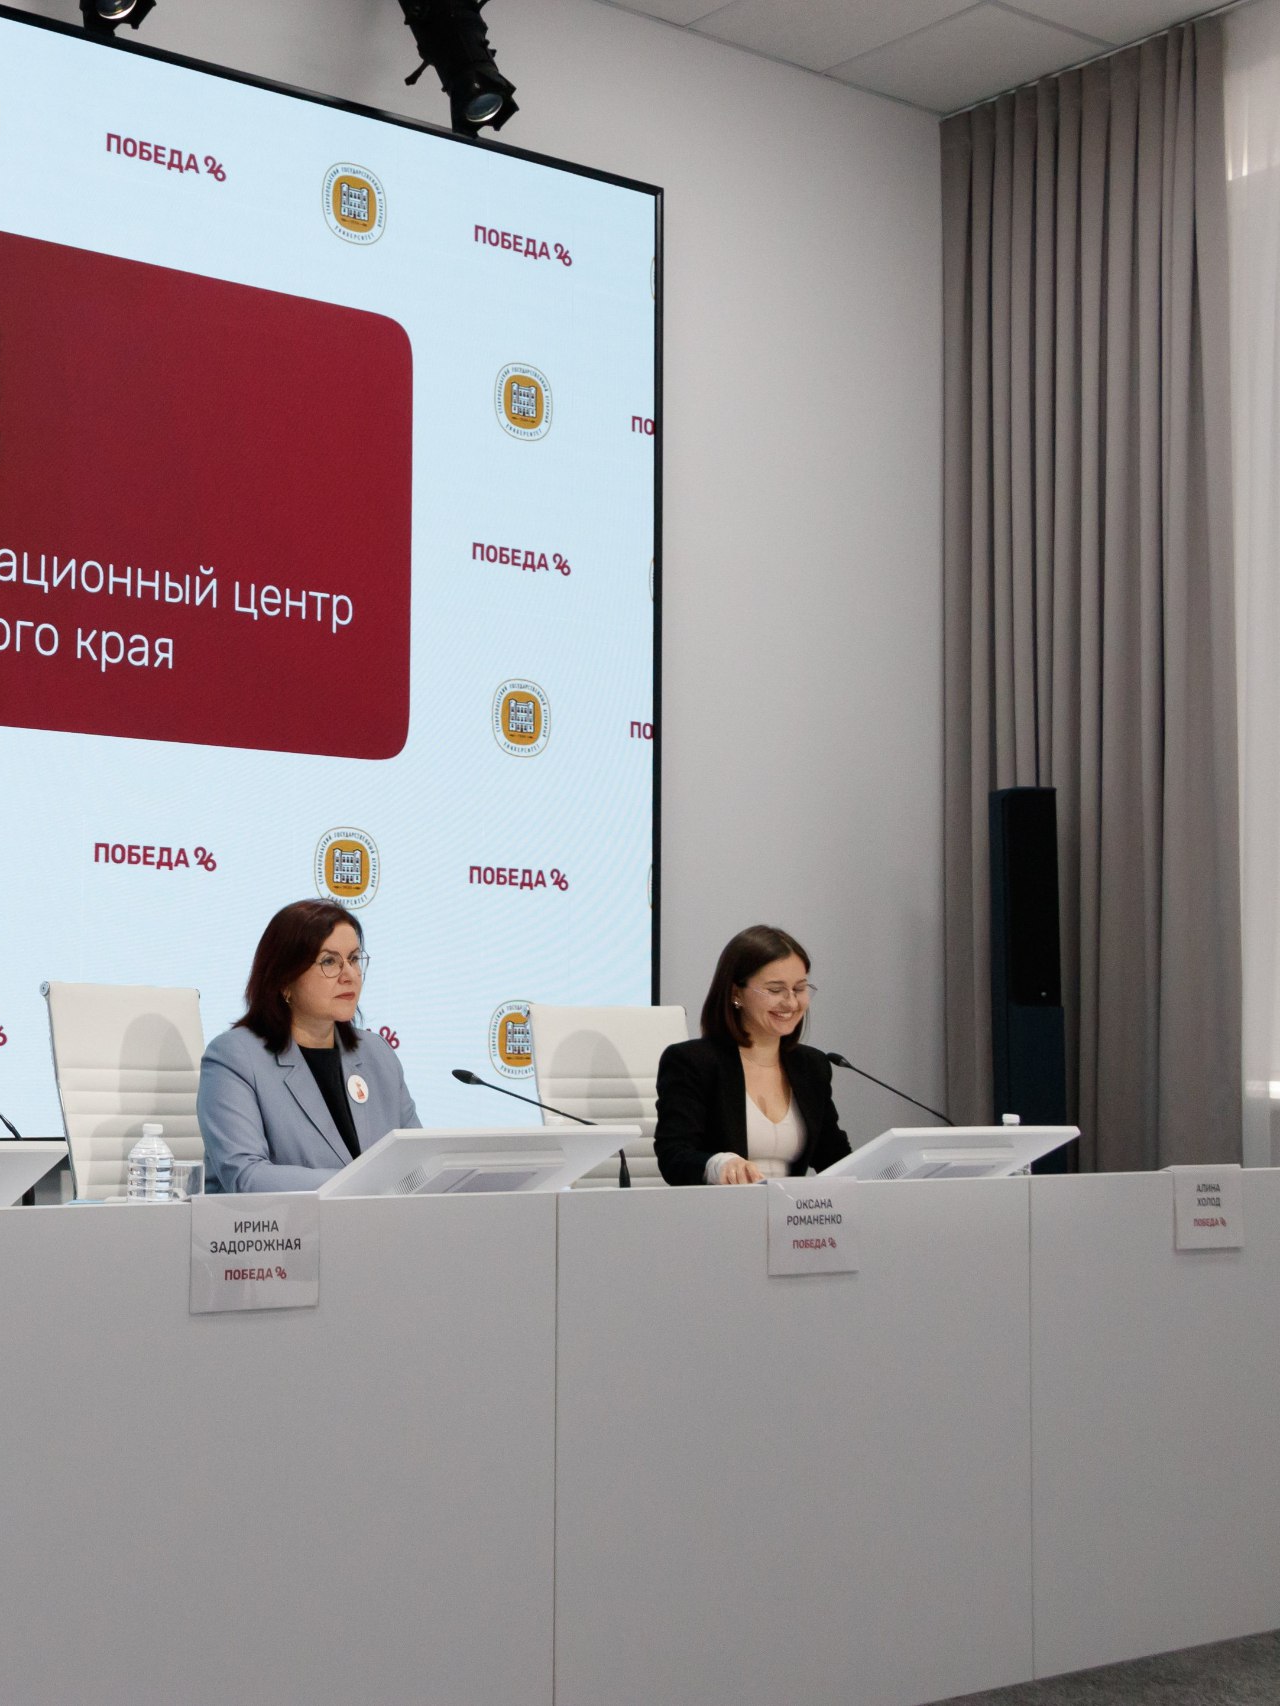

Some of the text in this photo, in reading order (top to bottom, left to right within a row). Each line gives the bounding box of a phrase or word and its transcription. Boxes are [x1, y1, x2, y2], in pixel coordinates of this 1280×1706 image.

[106, 133, 198, 172] ПОБЕДА
[474, 225, 550, 259] ПОБЕДА
[473, 543, 548, 571] ПОБЕДА
[234, 581, 353, 633] центр
[76, 627, 174, 672] края
[94, 843, 189, 871] ПОБЕДА
[469, 866, 547, 890] ПОБЕДА
[1196, 1183, 1221, 1193] АЛИНА
[795, 1198, 833, 1209] ОКСАНА
[1197, 1197, 1221, 1207] ХОЛОД
[234, 1220, 280, 1233] ИРИНА
[786, 1214, 842, 1226] РОМАНЕНКО
[209, 1238, 301, 1255] ЗАДОРОЖНАЯ
[792, 1239, 826, 1250] ПОБЕДА
[224, 1268, 273, 1281] ПОБЕДА
